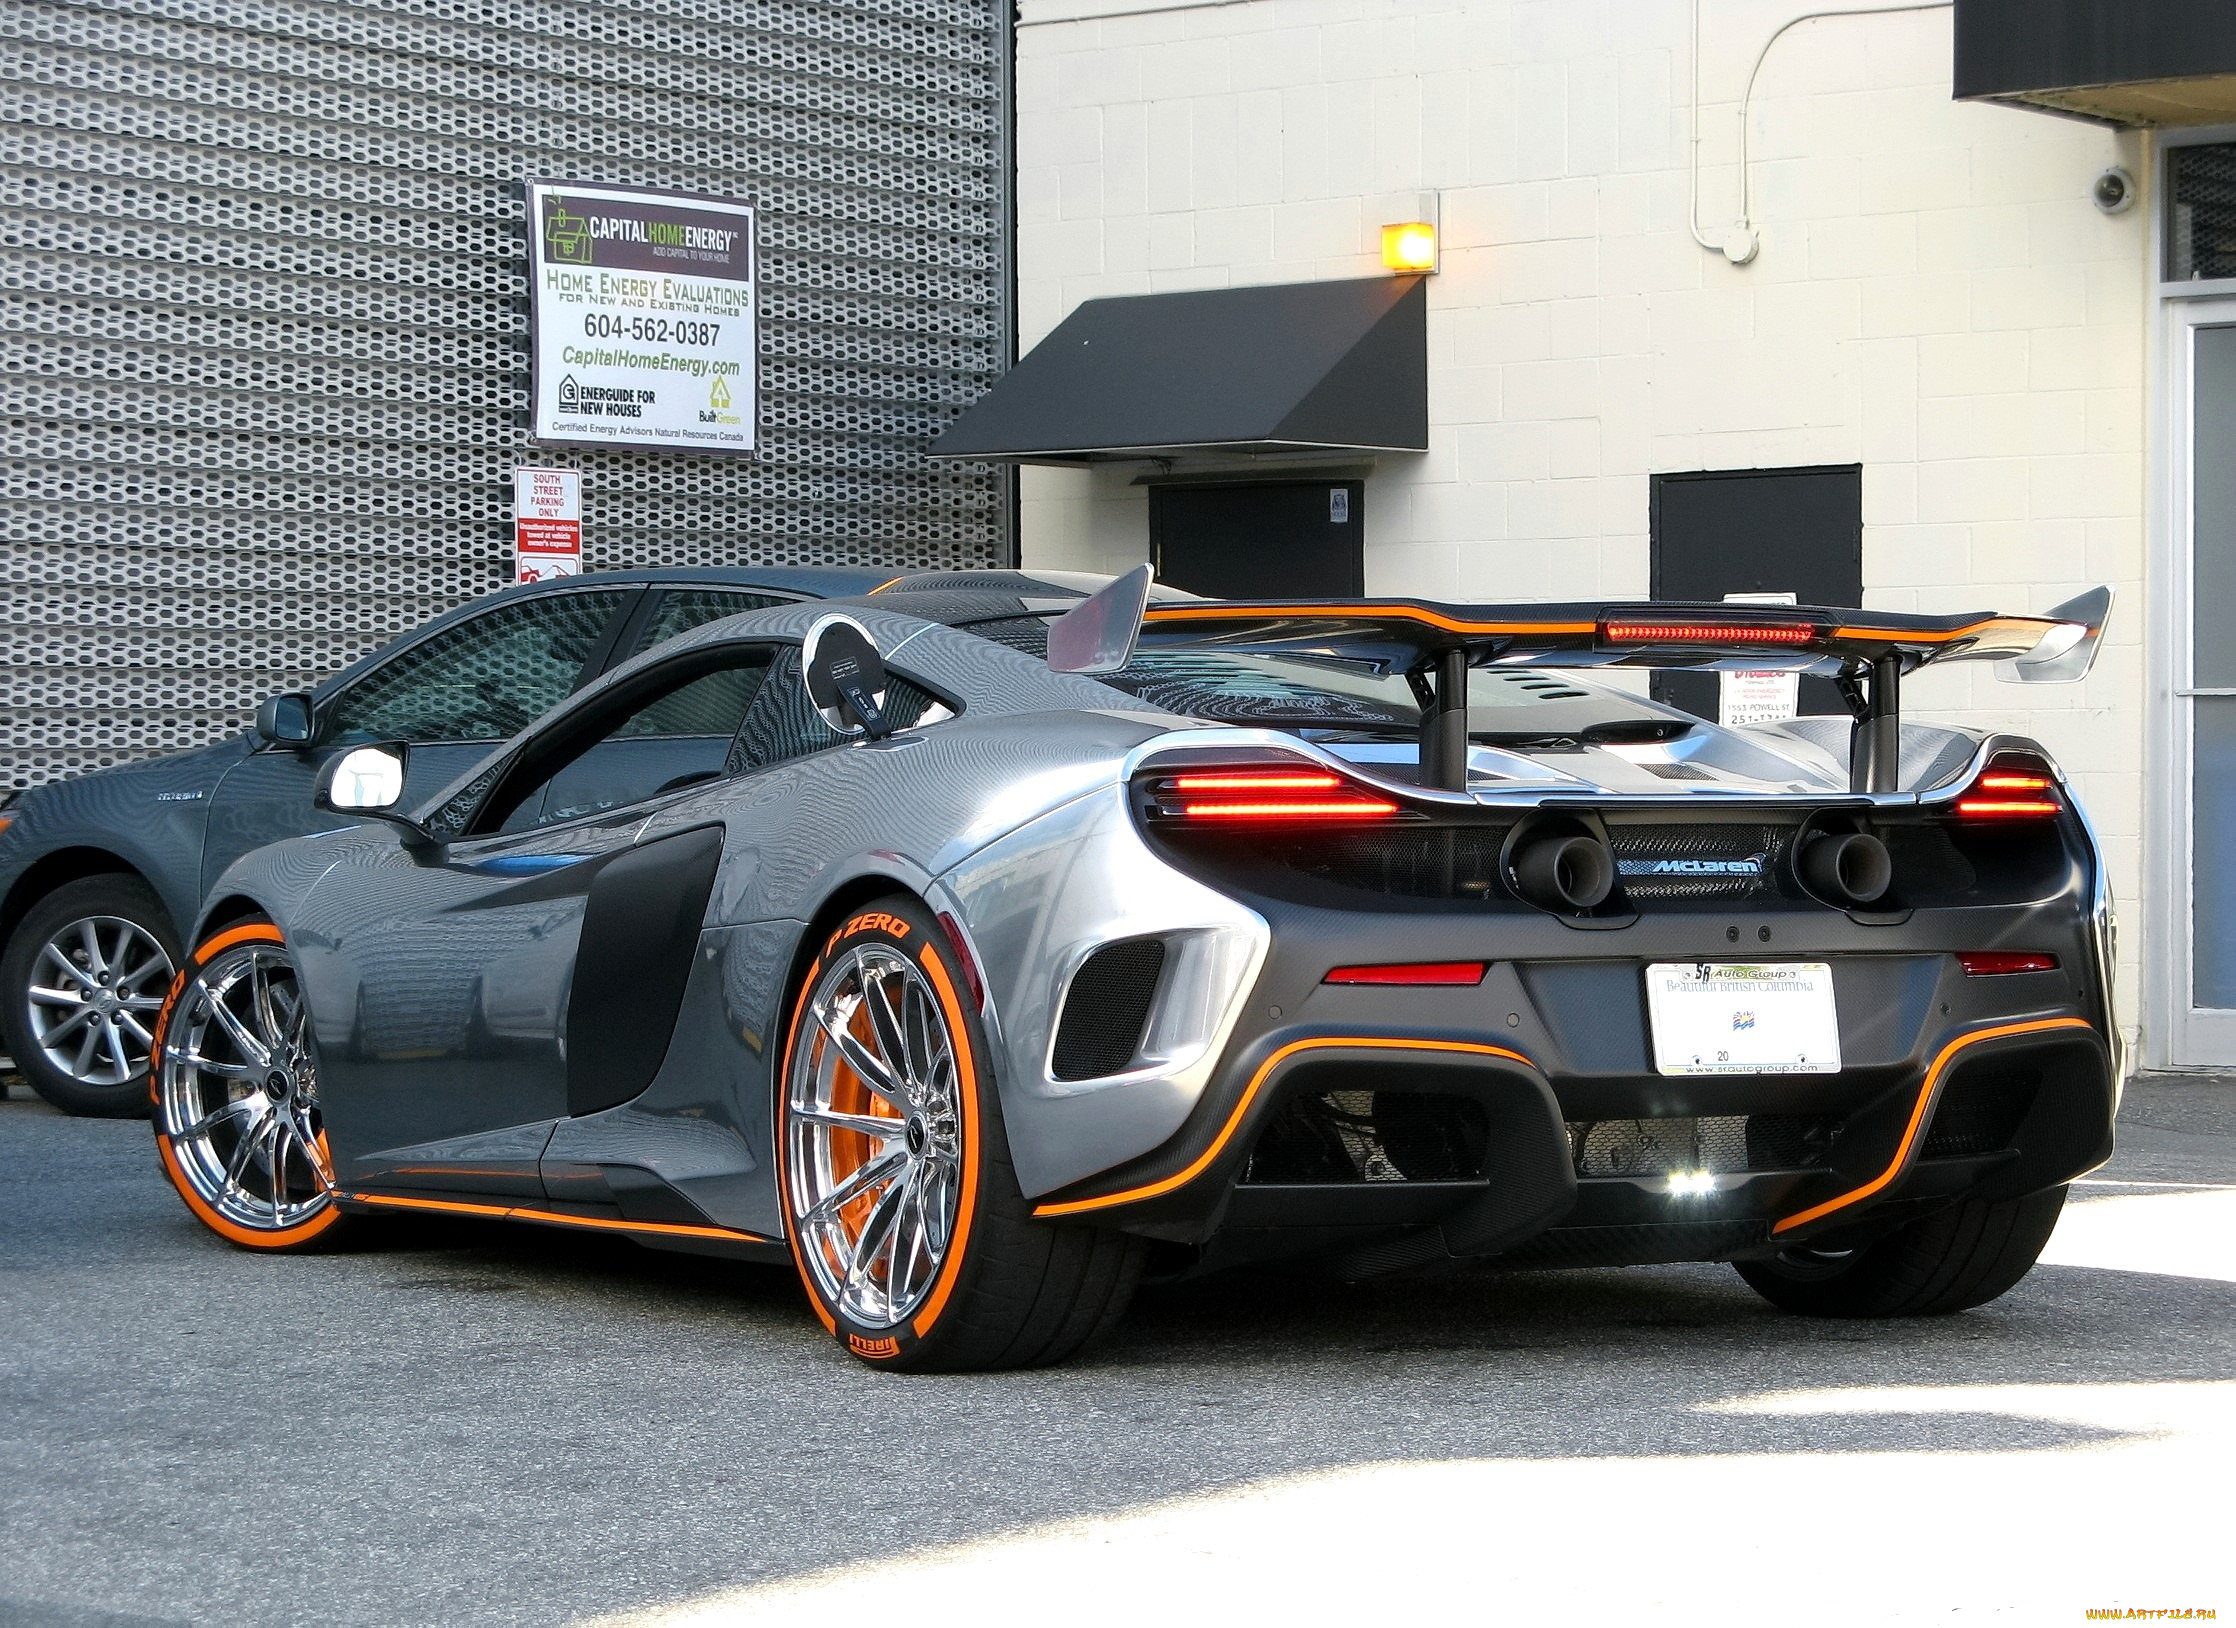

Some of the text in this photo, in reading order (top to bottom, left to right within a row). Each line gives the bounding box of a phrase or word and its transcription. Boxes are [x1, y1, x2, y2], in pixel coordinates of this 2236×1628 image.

[666, 247, 689, 260] CAPITAL
[690, 250, 698, 260] TO
[698, 250, 713, 262] YOUR
[546, 269, 749, 307] HOME ENERGY EVALUATIONS
[559, 293, 740, 317] FOR NEW AND EXISTING HOMES
[585, 313, 720, 347] 604-562-0387
[562, 346, 740, 377] CapitalHomeEnergy.com
[580, 386, 656, 404] ENERGUIDE FOR
[580, 402, 642, 418] NEW HOUSES
[552, 422, 744, 442] Certified Energy Advisors Natural Resources Canada
[533, 474, 560, 484] SOUTH
[533, 486, 563, 496] STREET
[531, 497, 564, 507] PARKING
[538, 508, 559, 517] ONLY
[1750, 703, 1780, 711] POWELL
[1652, 860, 1758, 872] McLaren
[825, 912, 911, 958] P ZERO
[1695, 962, 1787, 984] SR Auto Group
[1717, 1051, 1729, 1062] 20
[1685, 1064, 1818, 1075] www.srautogroup.com
